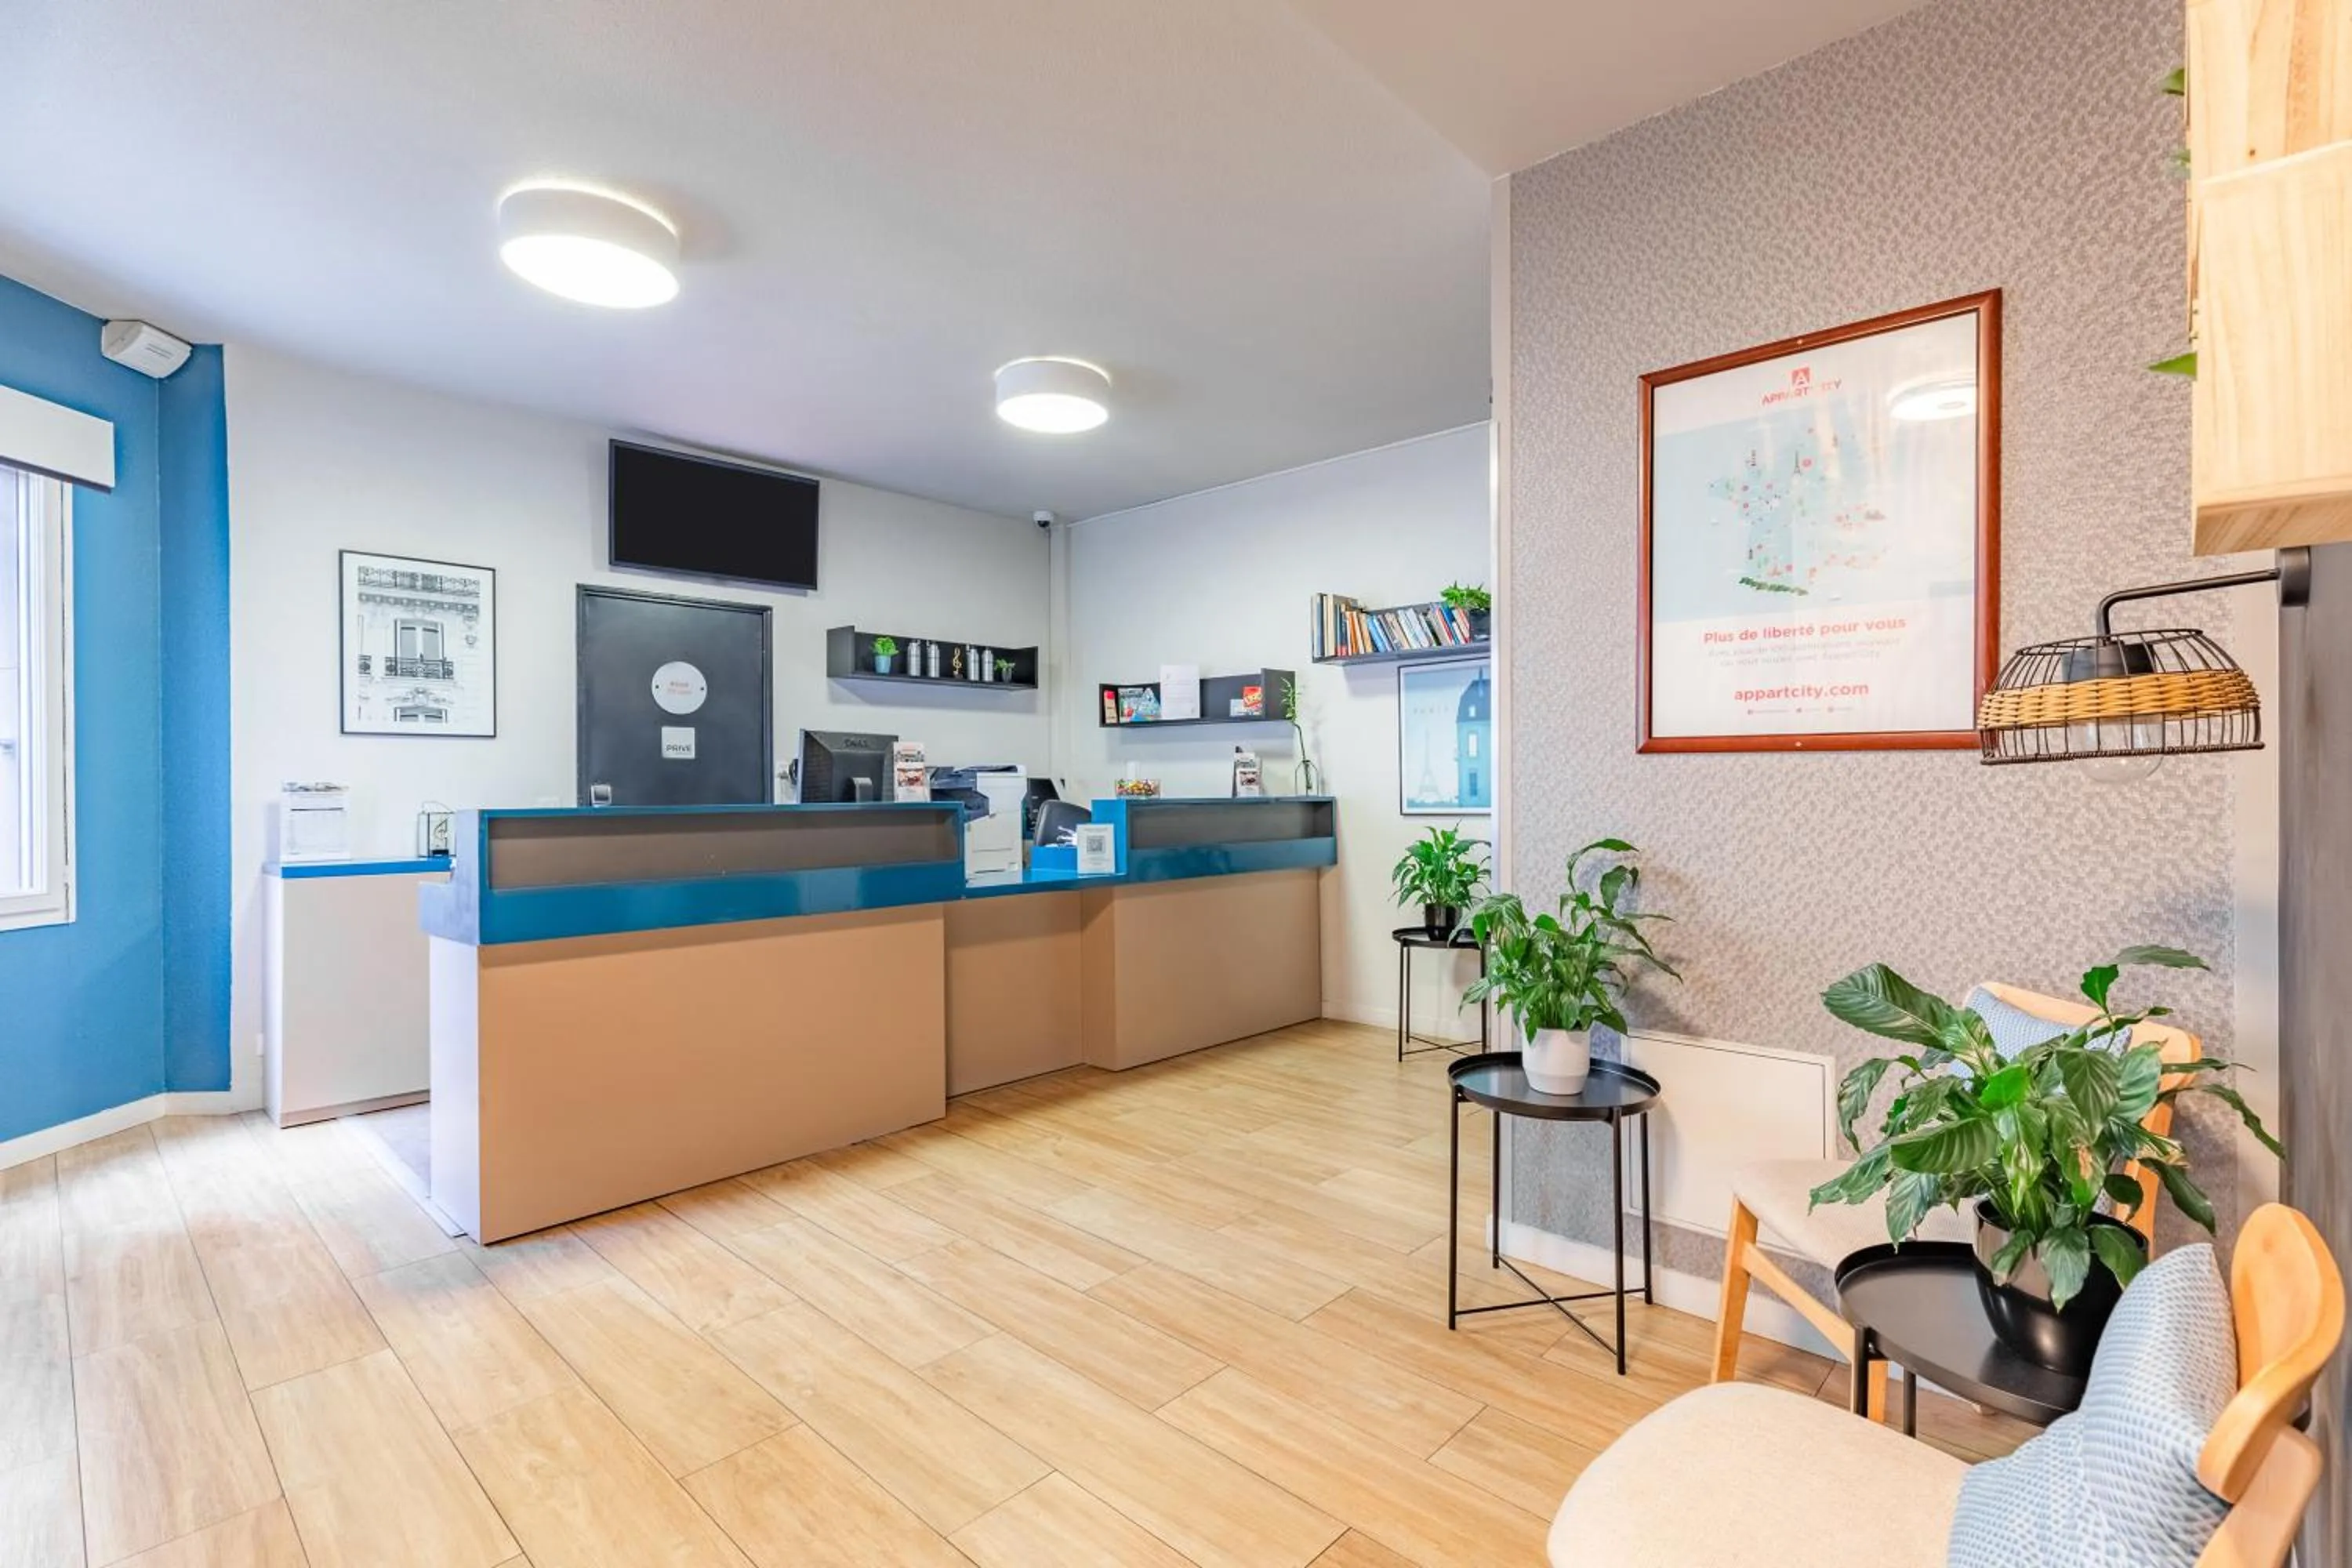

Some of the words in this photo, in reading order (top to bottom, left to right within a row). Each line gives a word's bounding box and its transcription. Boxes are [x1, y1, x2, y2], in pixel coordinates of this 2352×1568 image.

[1704, 631, 1734, 644] Plus
[1738, 629, 1758, 641] de
[1762, 622, 1815, 640] liberté
[1820, 622, 1860, 638] pour
[1865, 617, 1907, 632] vous
[1733, 683, 1869, 702] appartcity.com
